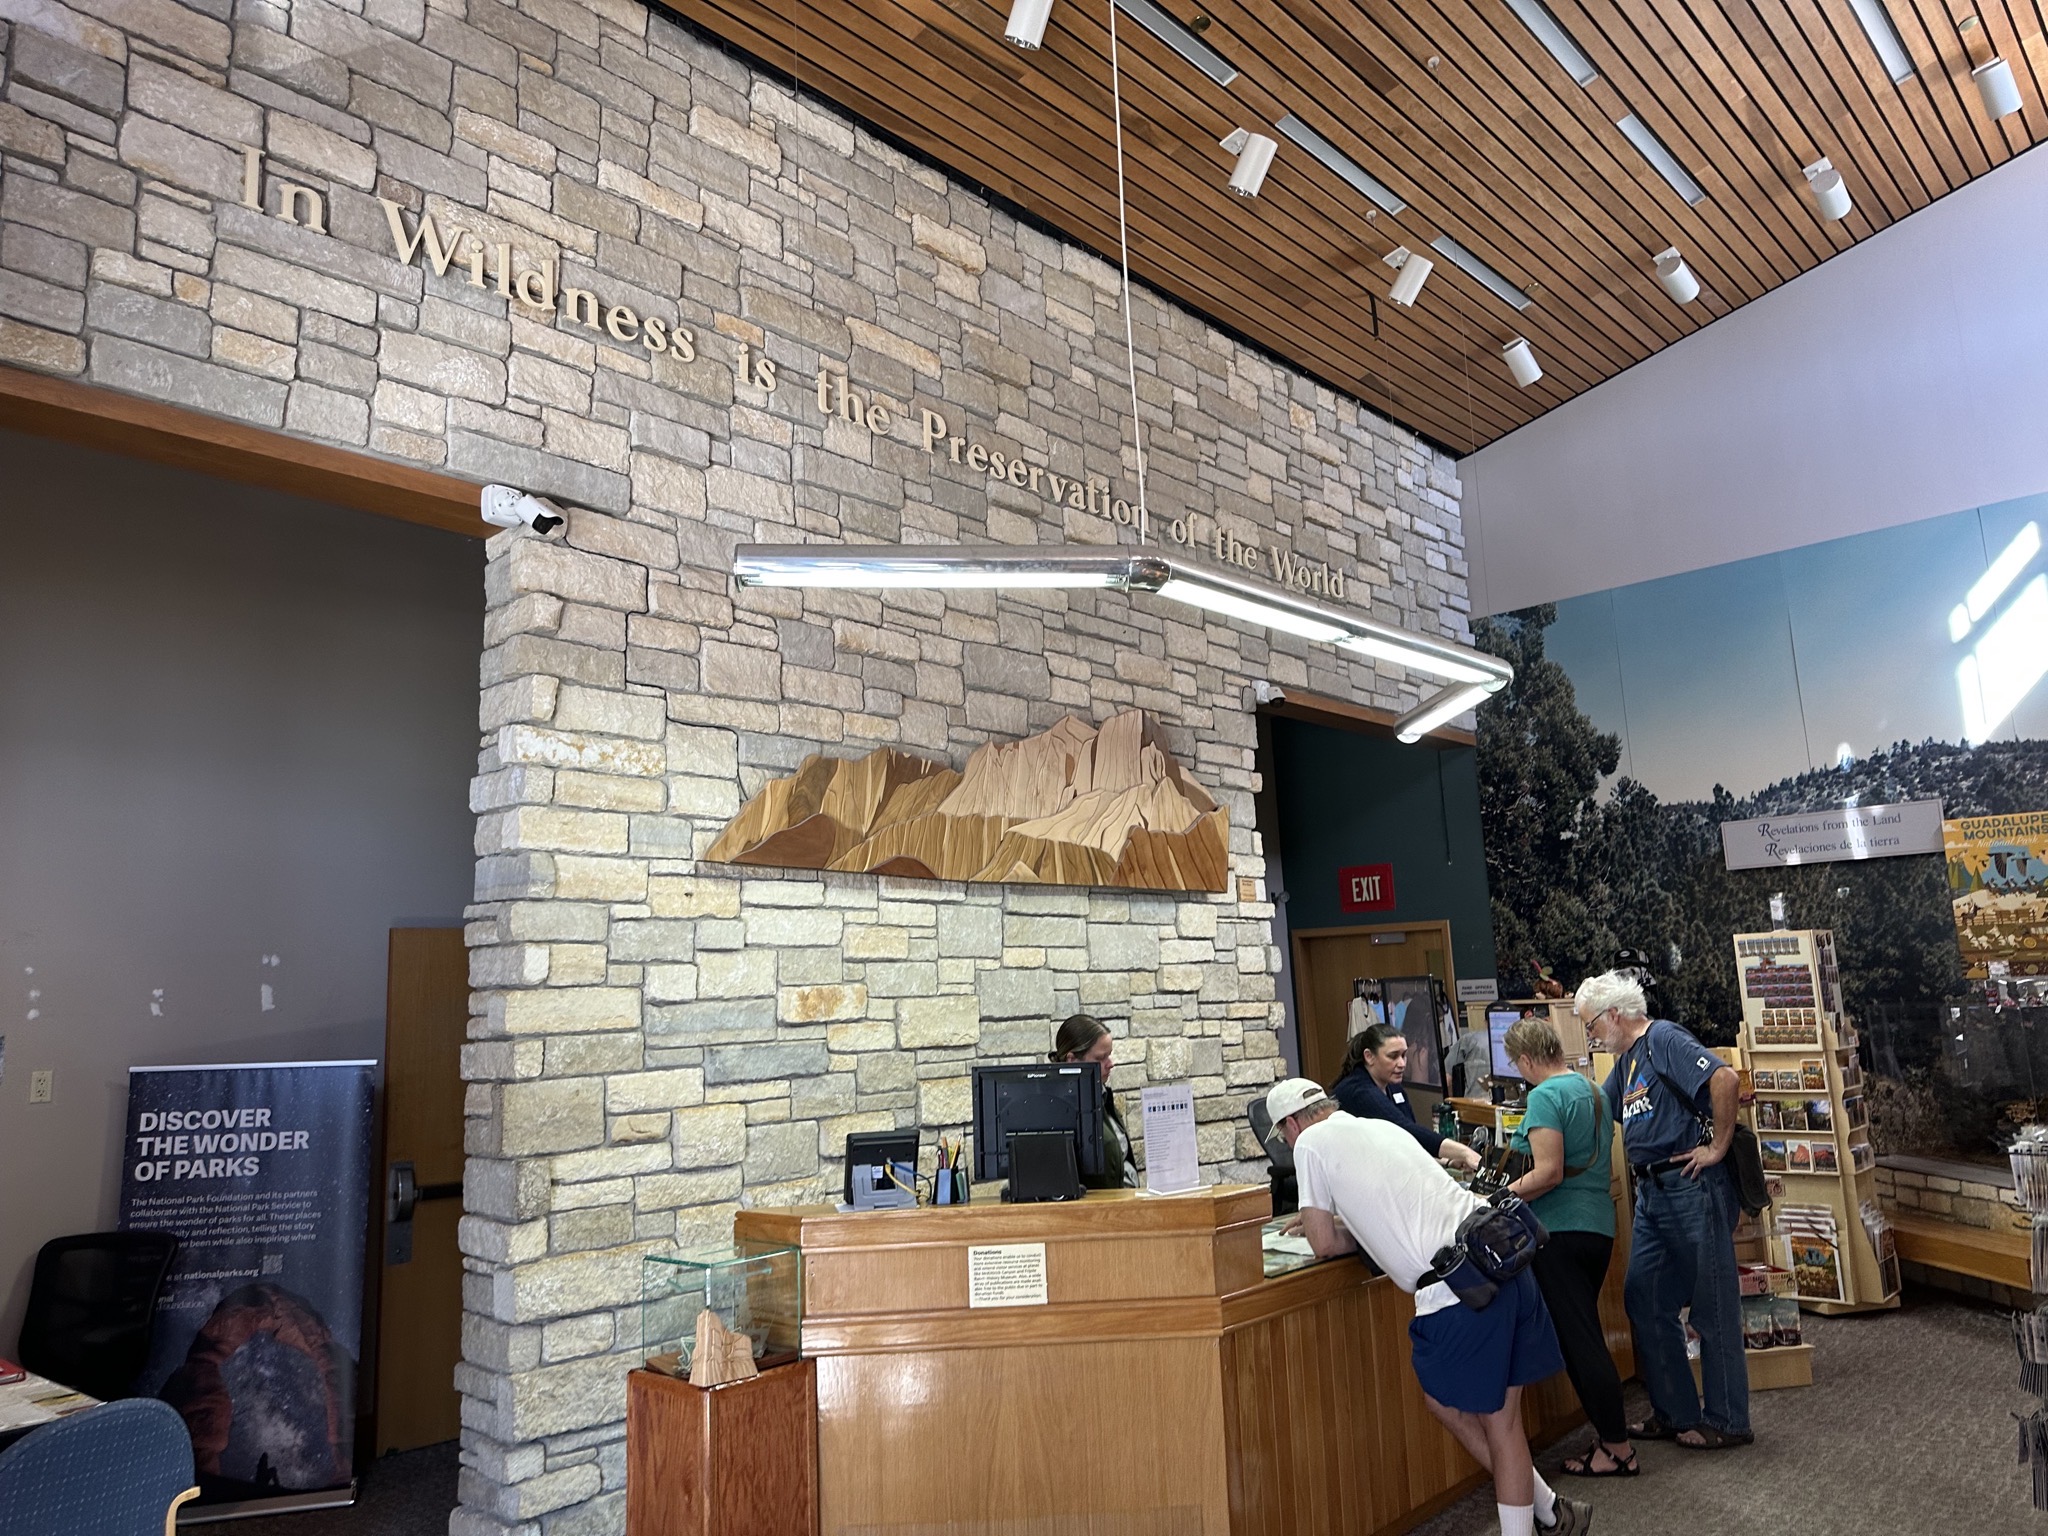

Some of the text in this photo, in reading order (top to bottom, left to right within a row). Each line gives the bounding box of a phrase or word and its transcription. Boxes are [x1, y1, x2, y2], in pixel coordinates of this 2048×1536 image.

[242, 144, 1346, 600] In Wildness is the Preservation of the World
[1757, 813, 1902, 842] Revelations from the Land
[1960, 814, 2048, 830] GUADALUPE
[1963, 825, 2048, 840] MOUNTAINS
[1765, 837, 1900, 862] Revelaciones de la tierra
[1977, 835, 2039, 848] National Park
[1351, 875, 1381, 903] EXIT
[139, 1108, 271, 1132] DISCOVER
[136, 1130, 310, 1157] THE WONDER
[134, 1156, 260, 1182] OF PARKS
[132, 1190, 318, 1206] The National Park Foundation and its partners
[130, 1208, 178, 1218] collaborate
[179, 1207, 198, 1215] with
[199, 1206, 214, 1214] the
[215, 1203, 251, 1214] National
[251, 1202, 270, 1211] Park
[129, 1221, 159, 1229] ensure
[159, 1219, 174, 1227] the
[175, 1217, 207, 1226] wonder
[208, 1216, 217, 1224] of
[218, 1215, 242, 1225] parks
[242, 1214, 255, 1223] for
[295, 1211, 322, 1220] places
[191, 1227, 207, 1236] and
[278, 1223, 293, 1231] the
[293, 1222, 315, 1231] story
[190, 1239, 211, 1248] been
[235, 1236, 254, 1245] also
[290, 1232, 316, 1241] where
[183, 1268, 259, 1281] nationalparks.org
